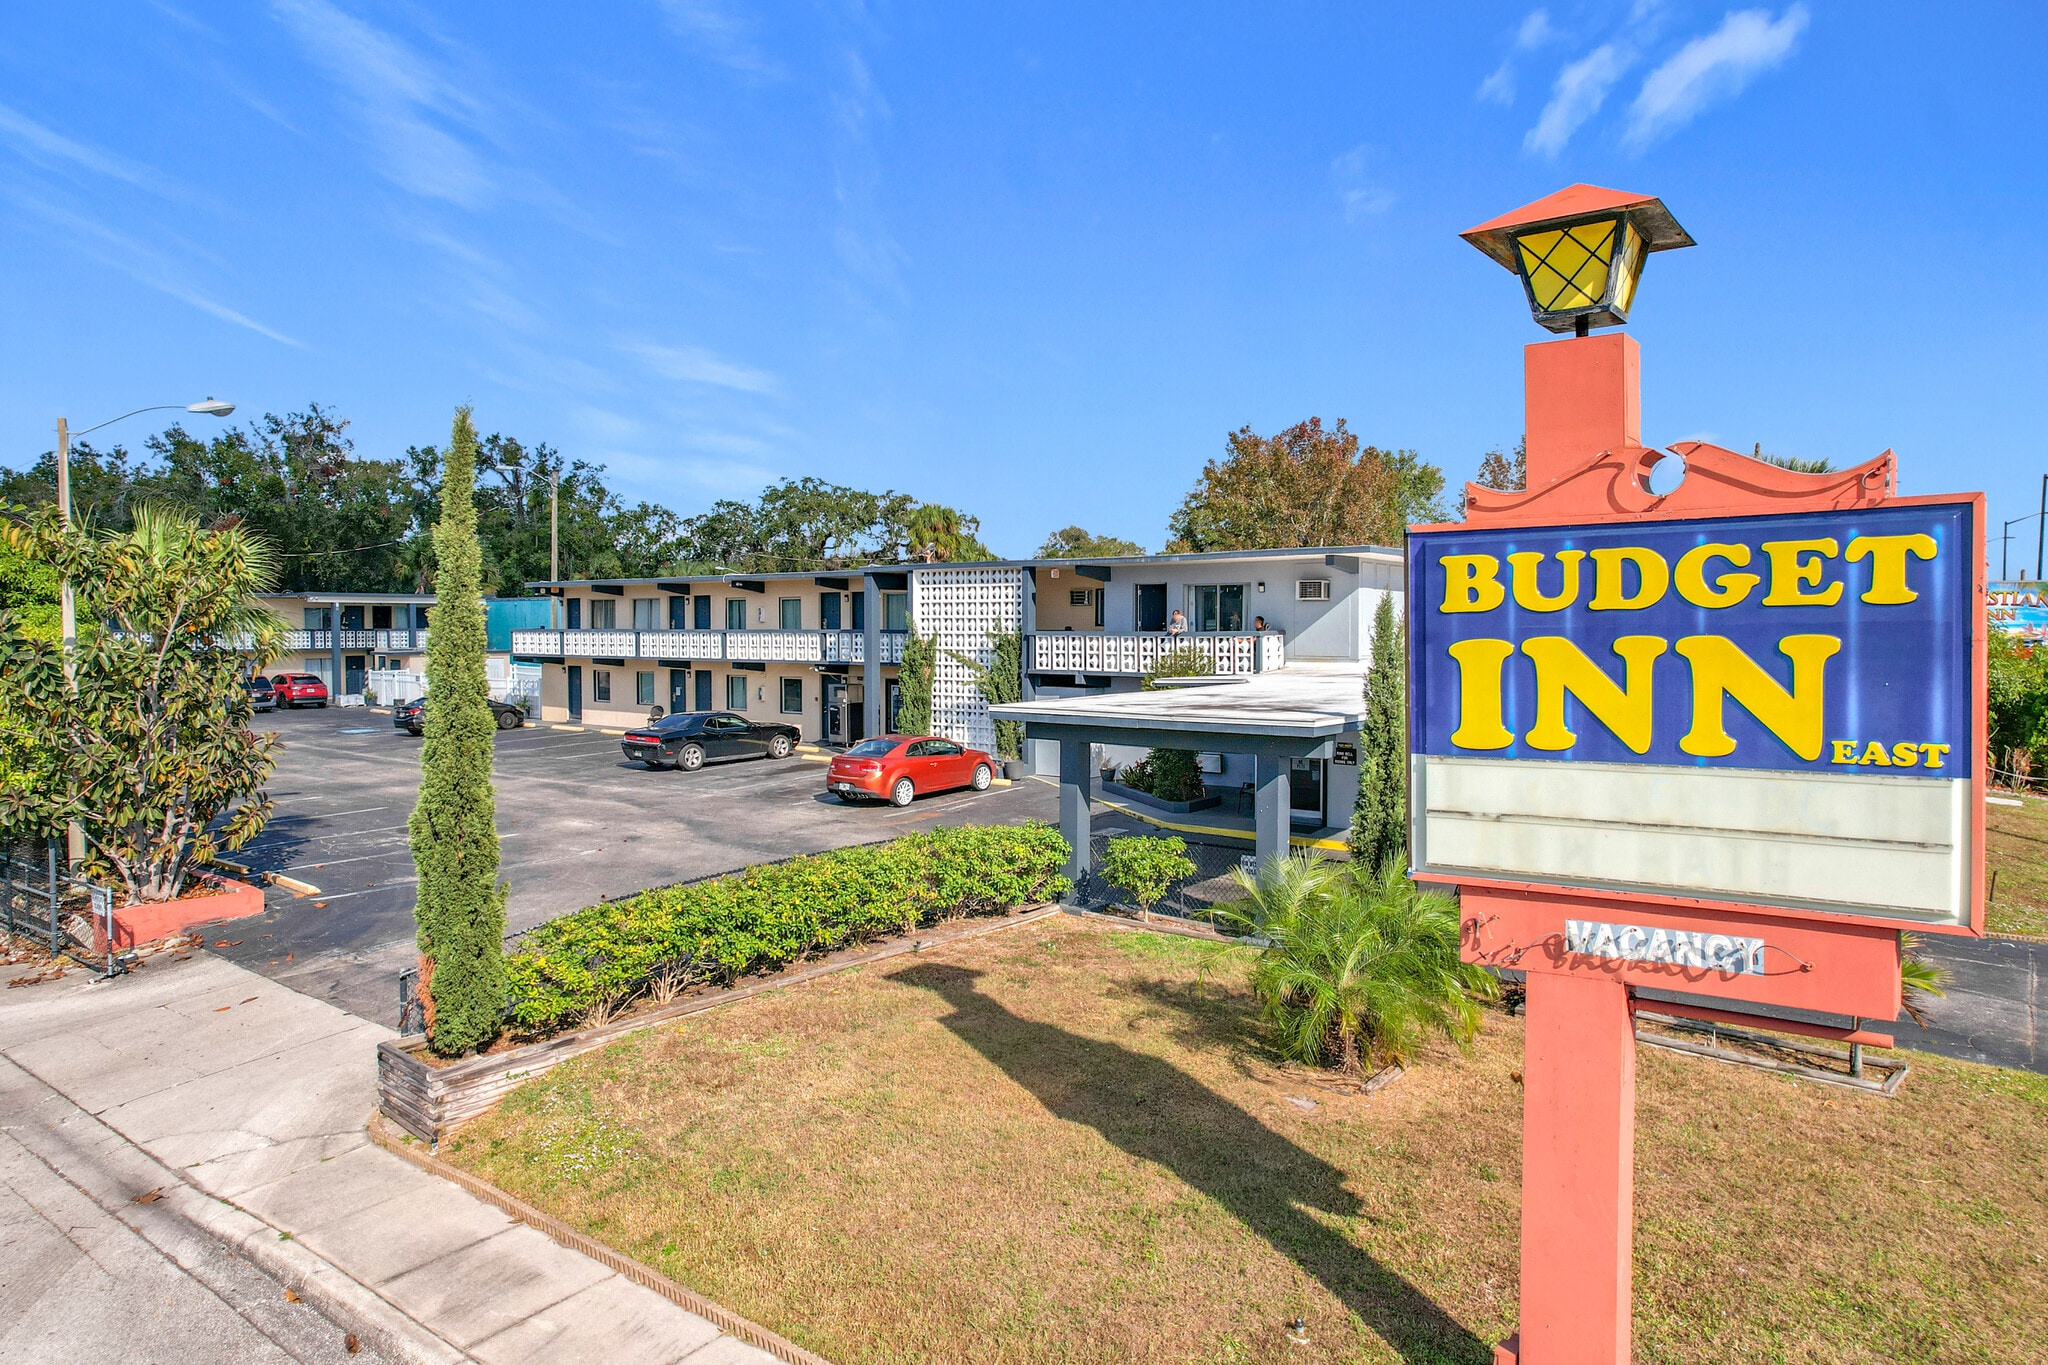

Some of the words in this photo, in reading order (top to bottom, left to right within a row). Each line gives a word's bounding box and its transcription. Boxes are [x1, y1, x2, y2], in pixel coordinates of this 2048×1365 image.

[1438, 533, 1938, 614] BUDGET
[1448, 634, 1842, 762] INN
[1831, 740, 1951, 768] EAST
[1567, 919, 1764, 975] VACANCY
